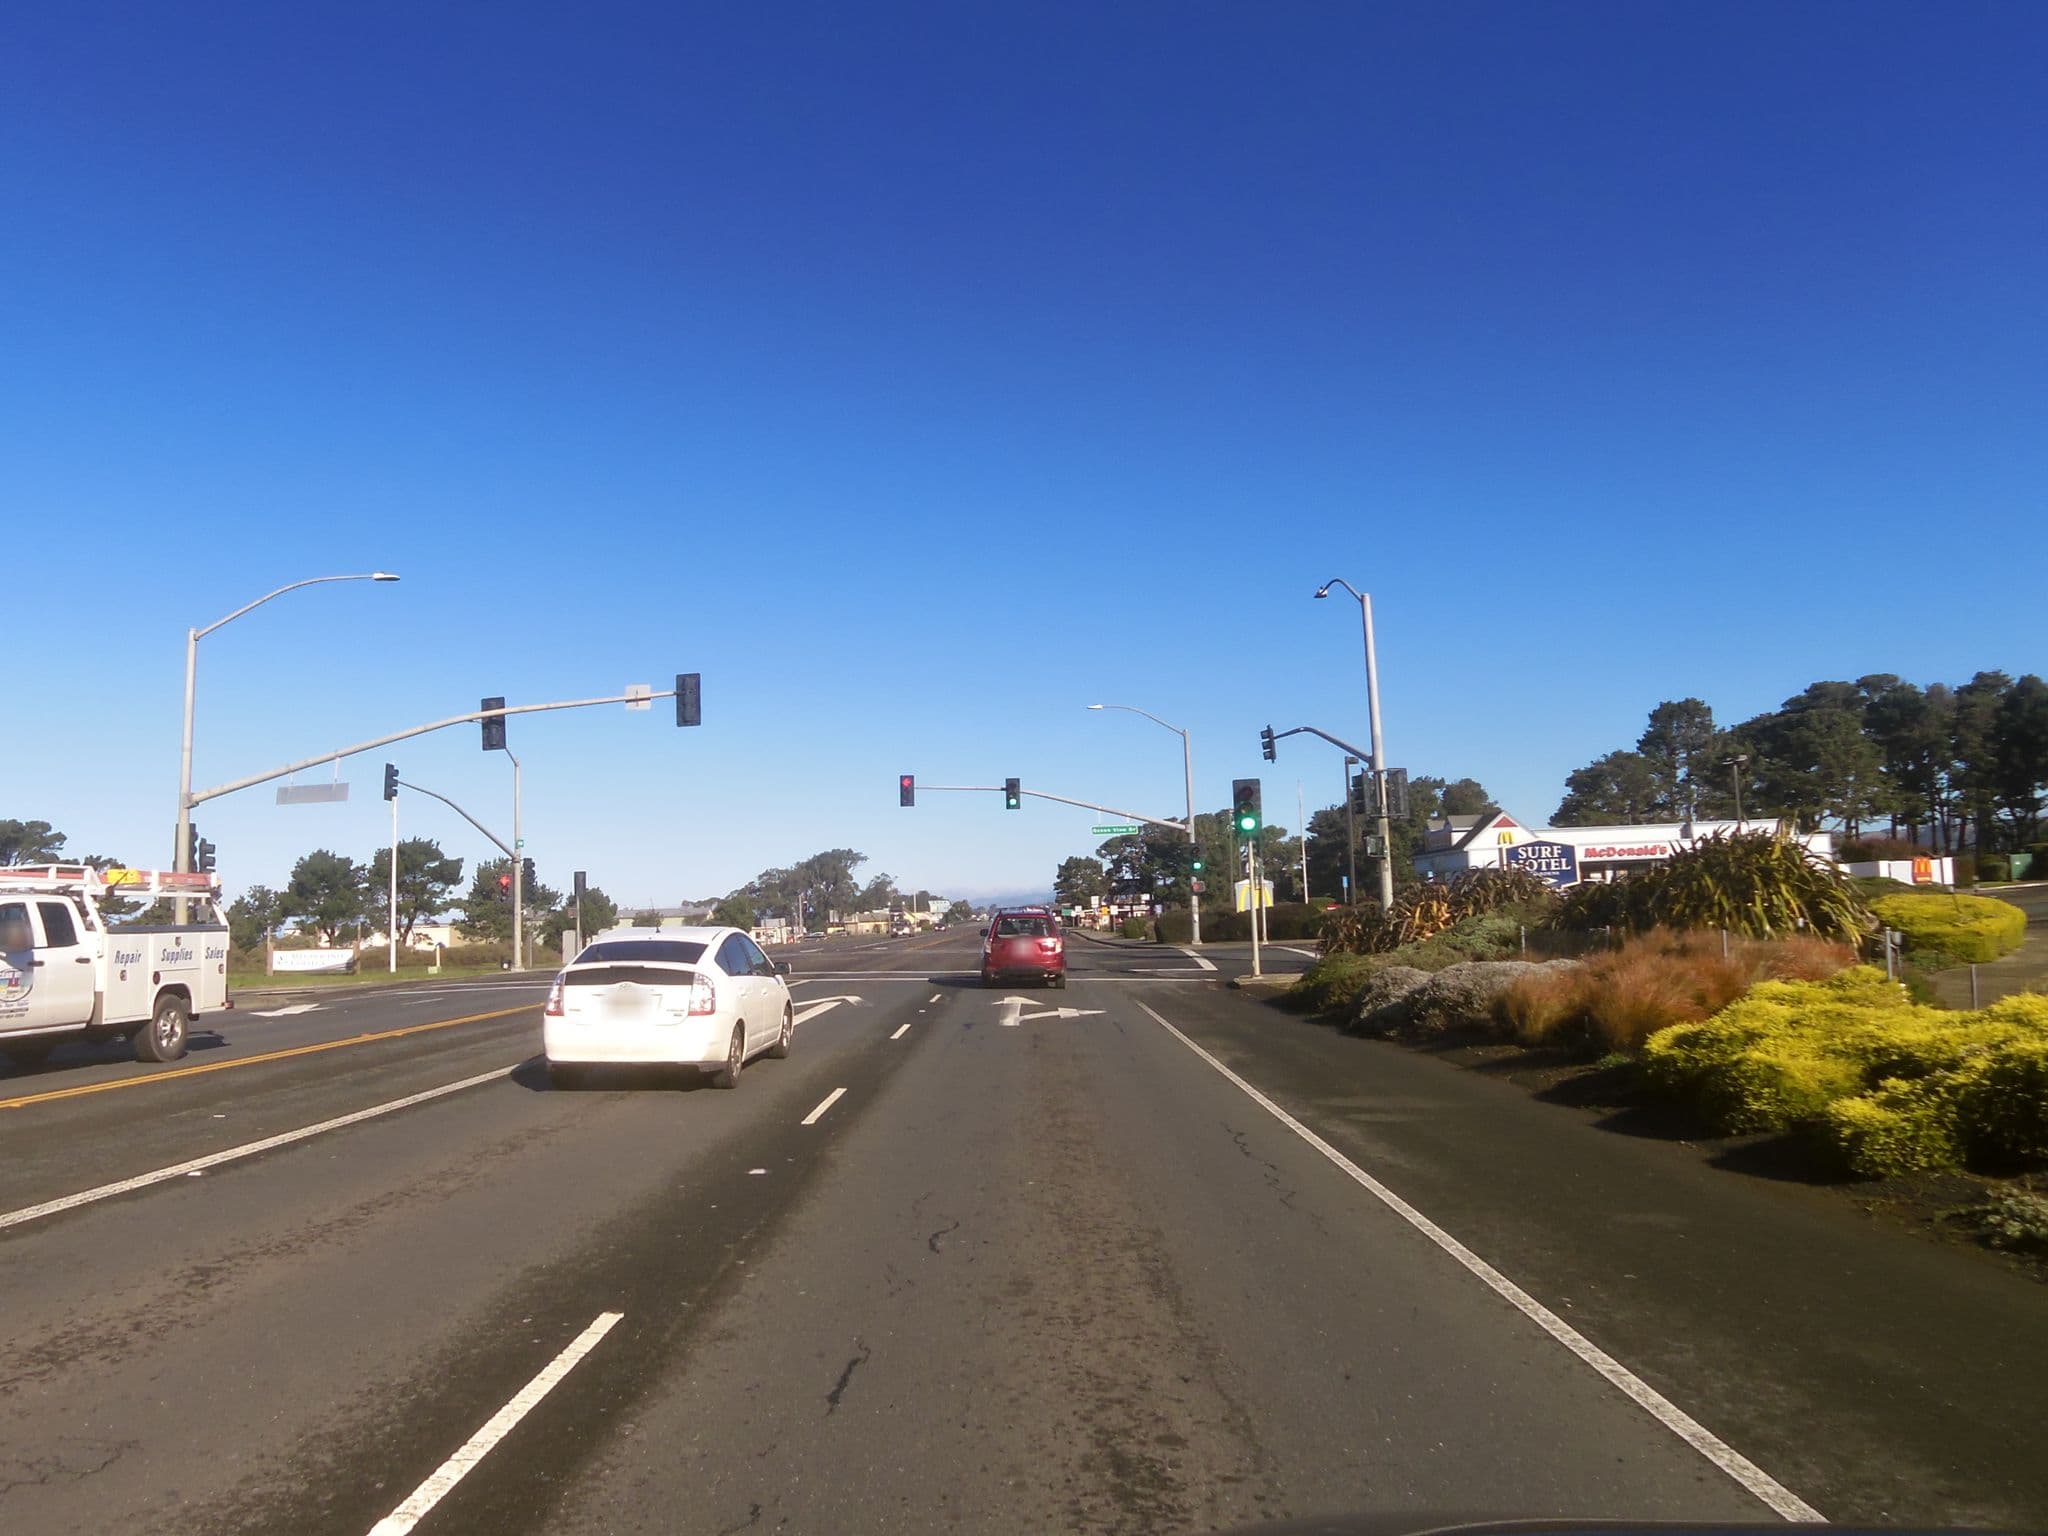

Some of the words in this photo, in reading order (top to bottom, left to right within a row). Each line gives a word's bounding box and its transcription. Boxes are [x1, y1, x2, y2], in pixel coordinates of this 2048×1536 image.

[1518, 846, 1562, 859] SURF
[1584, 845, 1667, 858] McDonald's
[115, 950, 142, 966] Repair
[161, 948, 193, 965] Supplies
[205, 947, 225, 960] Sales
